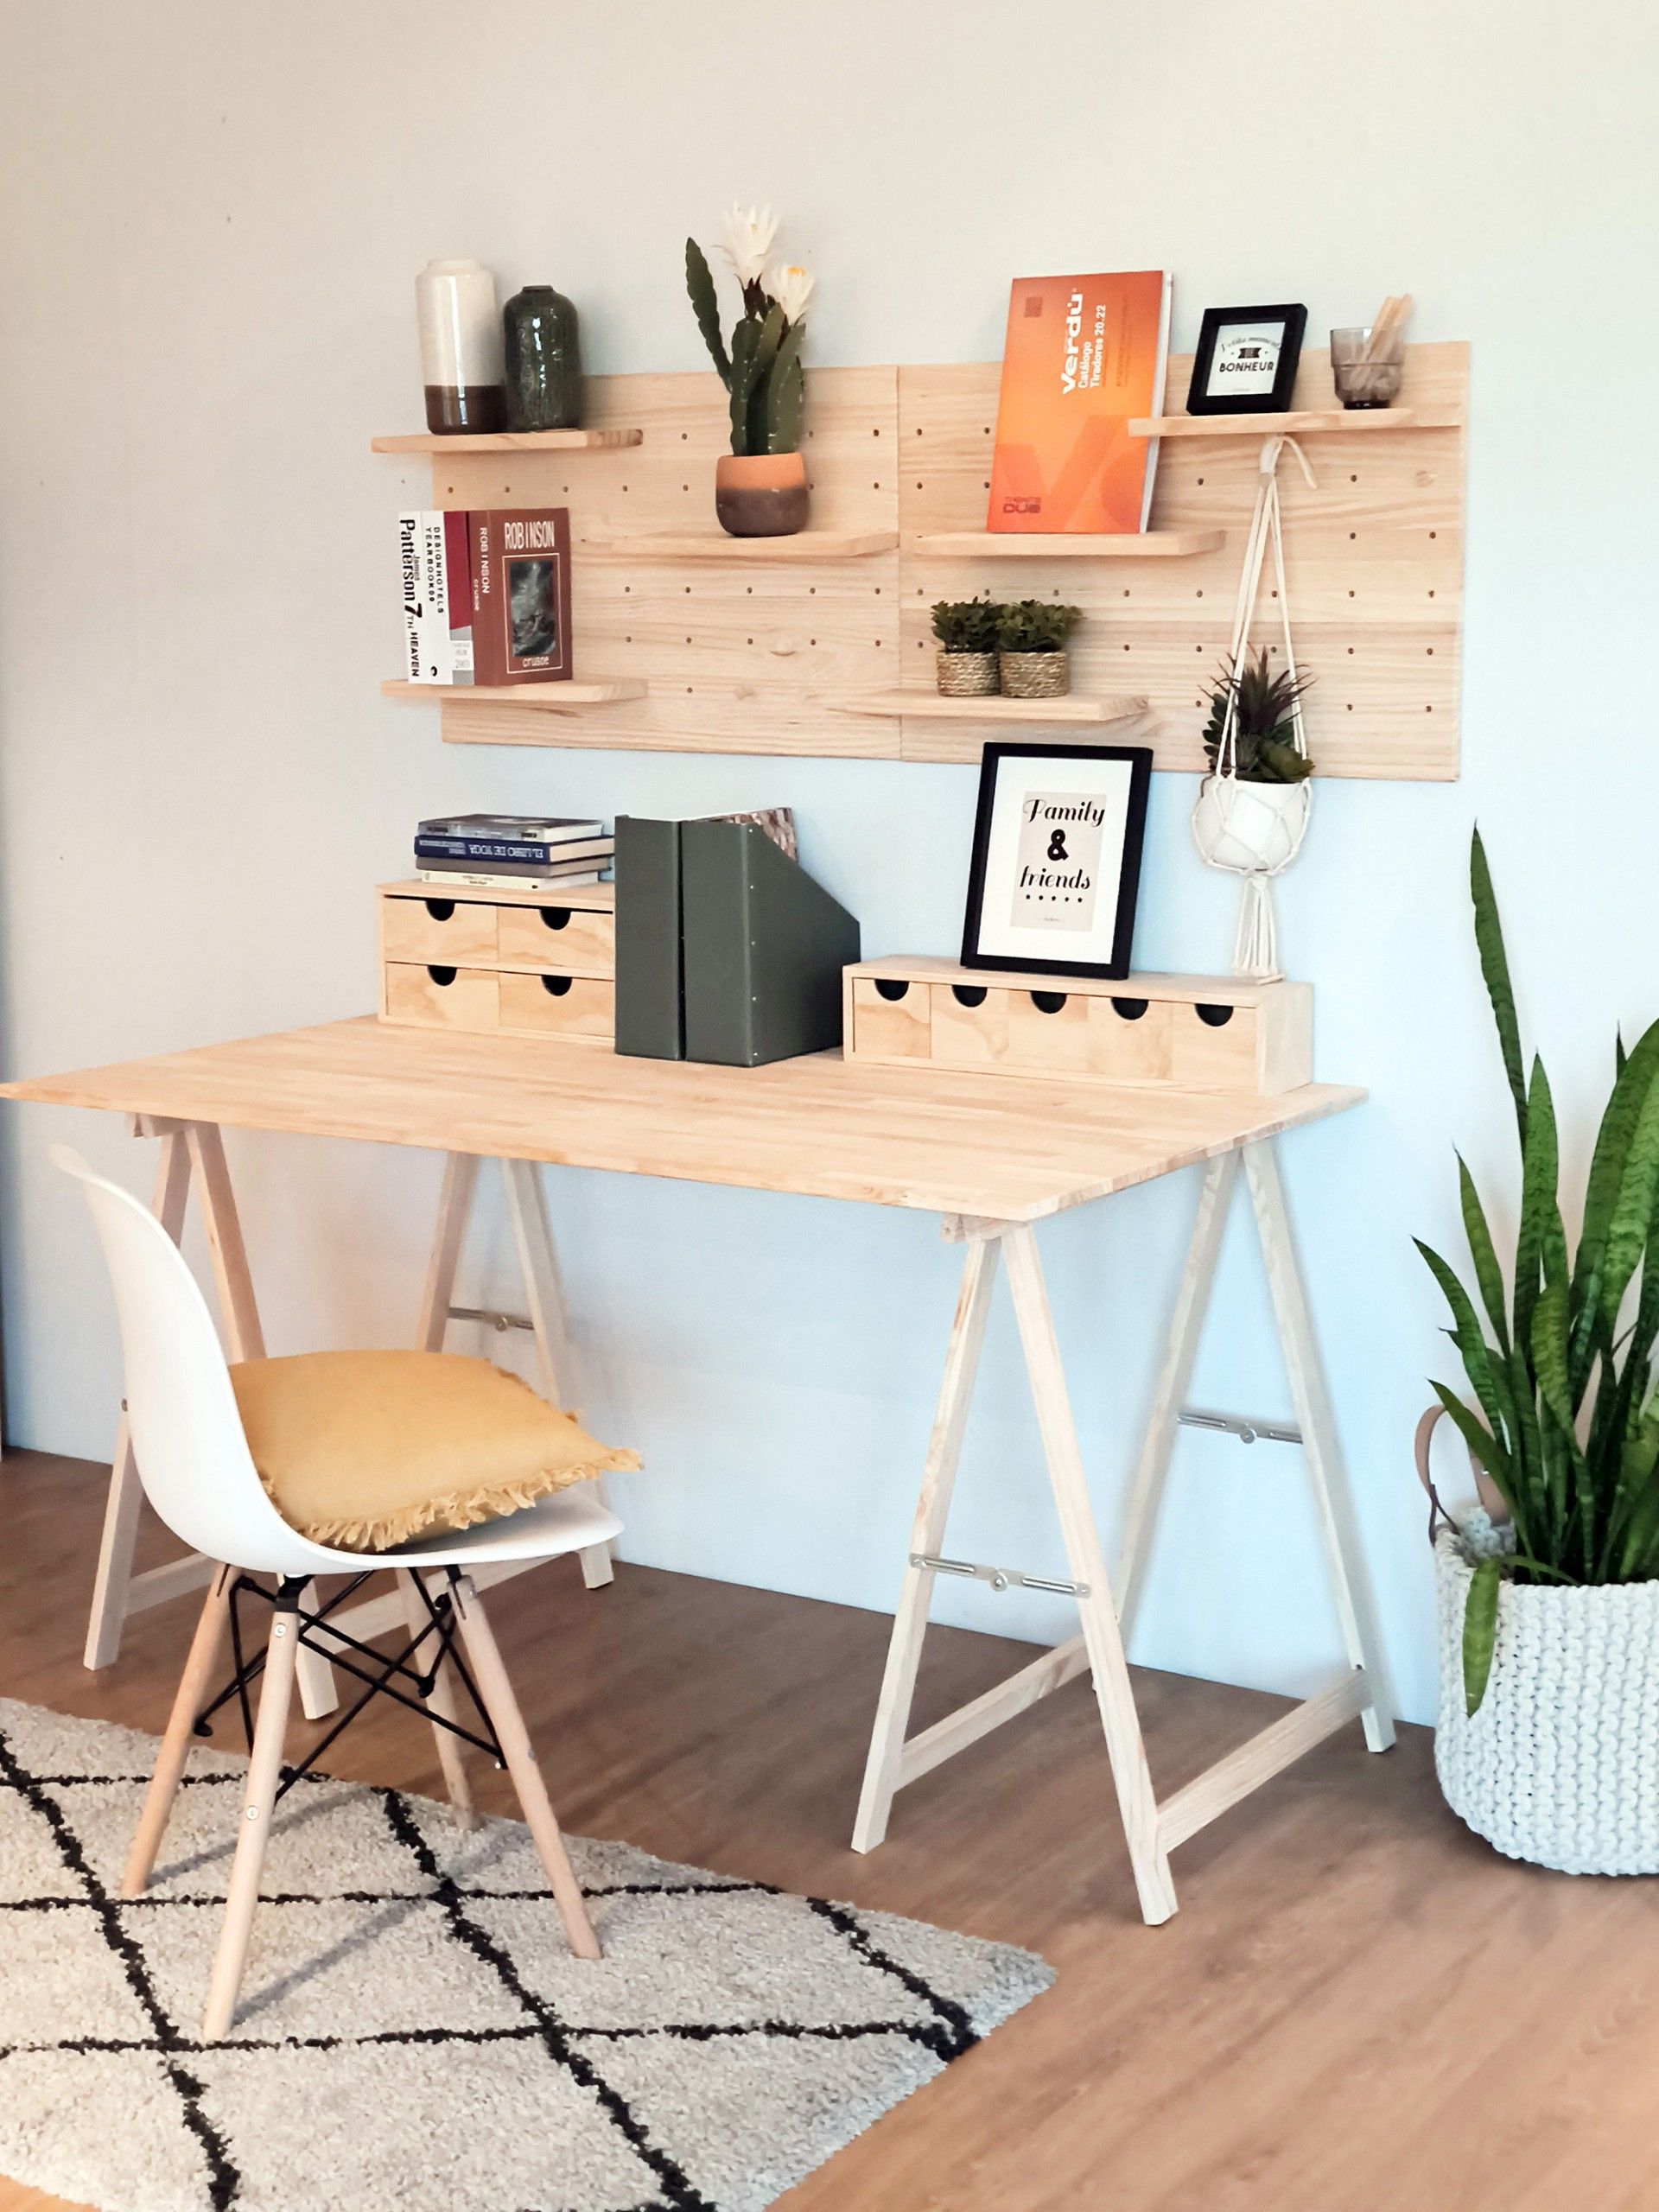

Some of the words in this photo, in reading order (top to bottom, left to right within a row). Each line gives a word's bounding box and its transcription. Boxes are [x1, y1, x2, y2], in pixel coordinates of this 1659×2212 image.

[1090, 338, 1103, 388] Tiradores
[1219, 361, 1282, 372] BONHEUR
[504, 520, 555, 550] ROBINSON
[480, 526, 490, 594] ROBINSON
[400, 518, 416, 601] Patterson
[410, 632, 420, 677] HEAVEN
[1023, 798, 1106, 828] Family
[1047, 830, 1069, 861] &
[1019, 865, 1090, 890] friends
